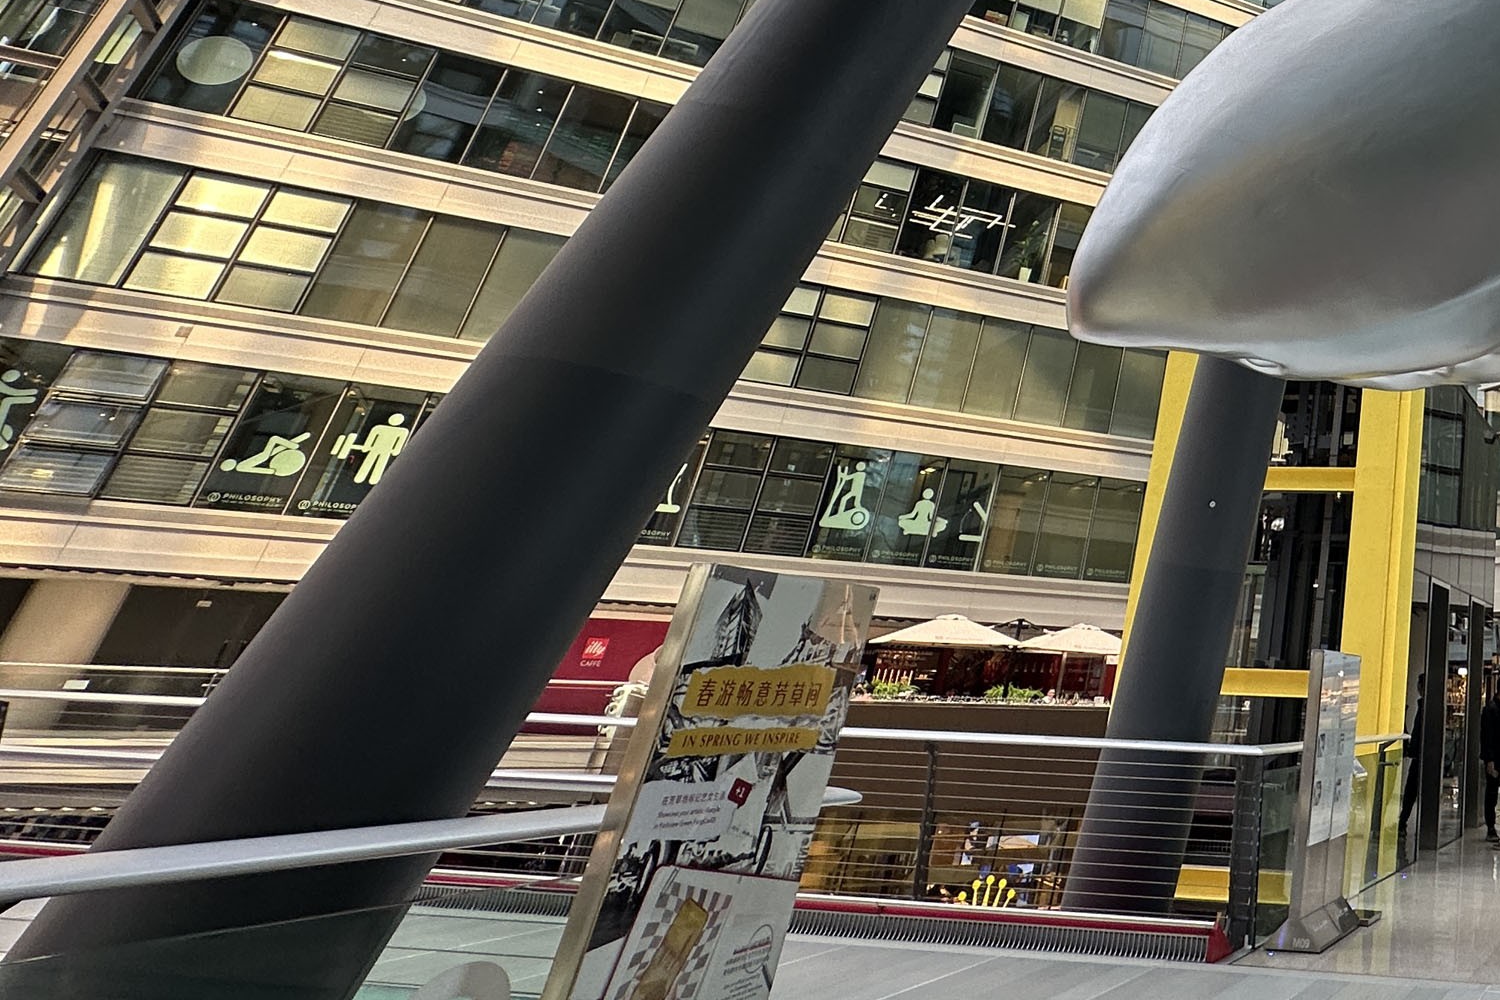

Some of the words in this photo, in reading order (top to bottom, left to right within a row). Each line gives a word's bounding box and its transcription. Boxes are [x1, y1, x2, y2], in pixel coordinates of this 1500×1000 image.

[222, 492, 283, 503] PHILOSOPHY
[822, 544, 861, 553] PHILOSOPHY
[882, 550, 918, 558] PHILOSOPHY
[938, 555, 975, 563] PHILOSOPHY
[584, 640, 606, 657] illy
[696, 678, 823, 707] 春游畅意芳草间
[682, 735, 697, 747] IN
[700, 733, 742, 747] SPRING
[743, 733, 760, 745] WE
[762, 731, 800, 744] INSPIRE
